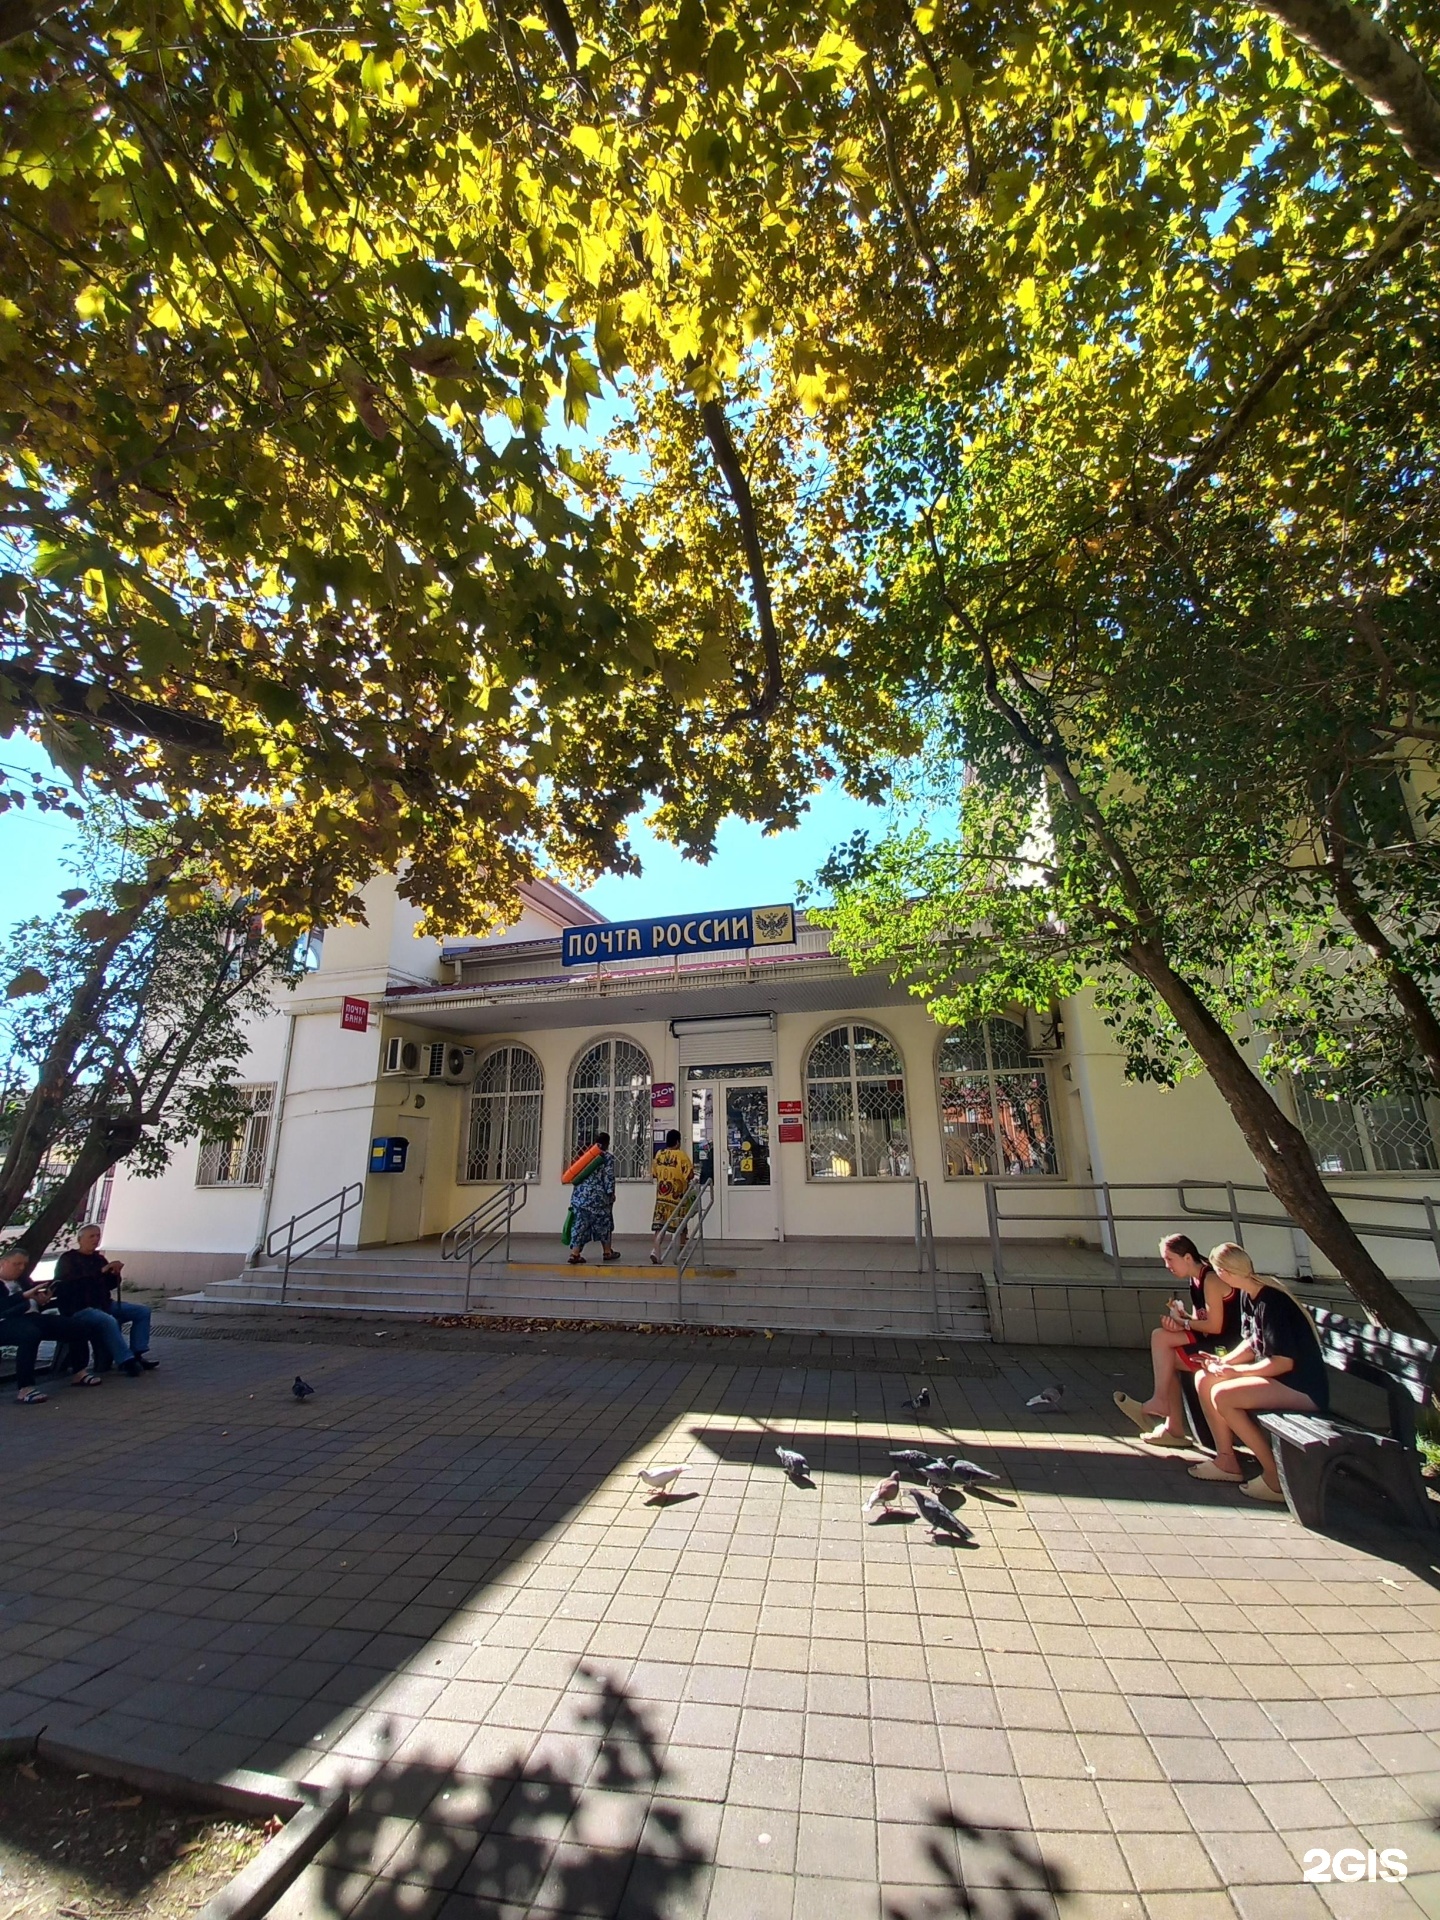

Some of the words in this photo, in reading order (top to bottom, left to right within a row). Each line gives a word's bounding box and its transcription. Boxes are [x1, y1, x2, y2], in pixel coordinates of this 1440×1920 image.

[568, 928, 642, 957] ПОЧТА
[652, 916, 749, 949] РОССИИ
[345, 1004, 367, 1016] ПОЧТА
[344, 1013, 363, 1025] БАНК
[651, 1086, 674, 1099] OZON
